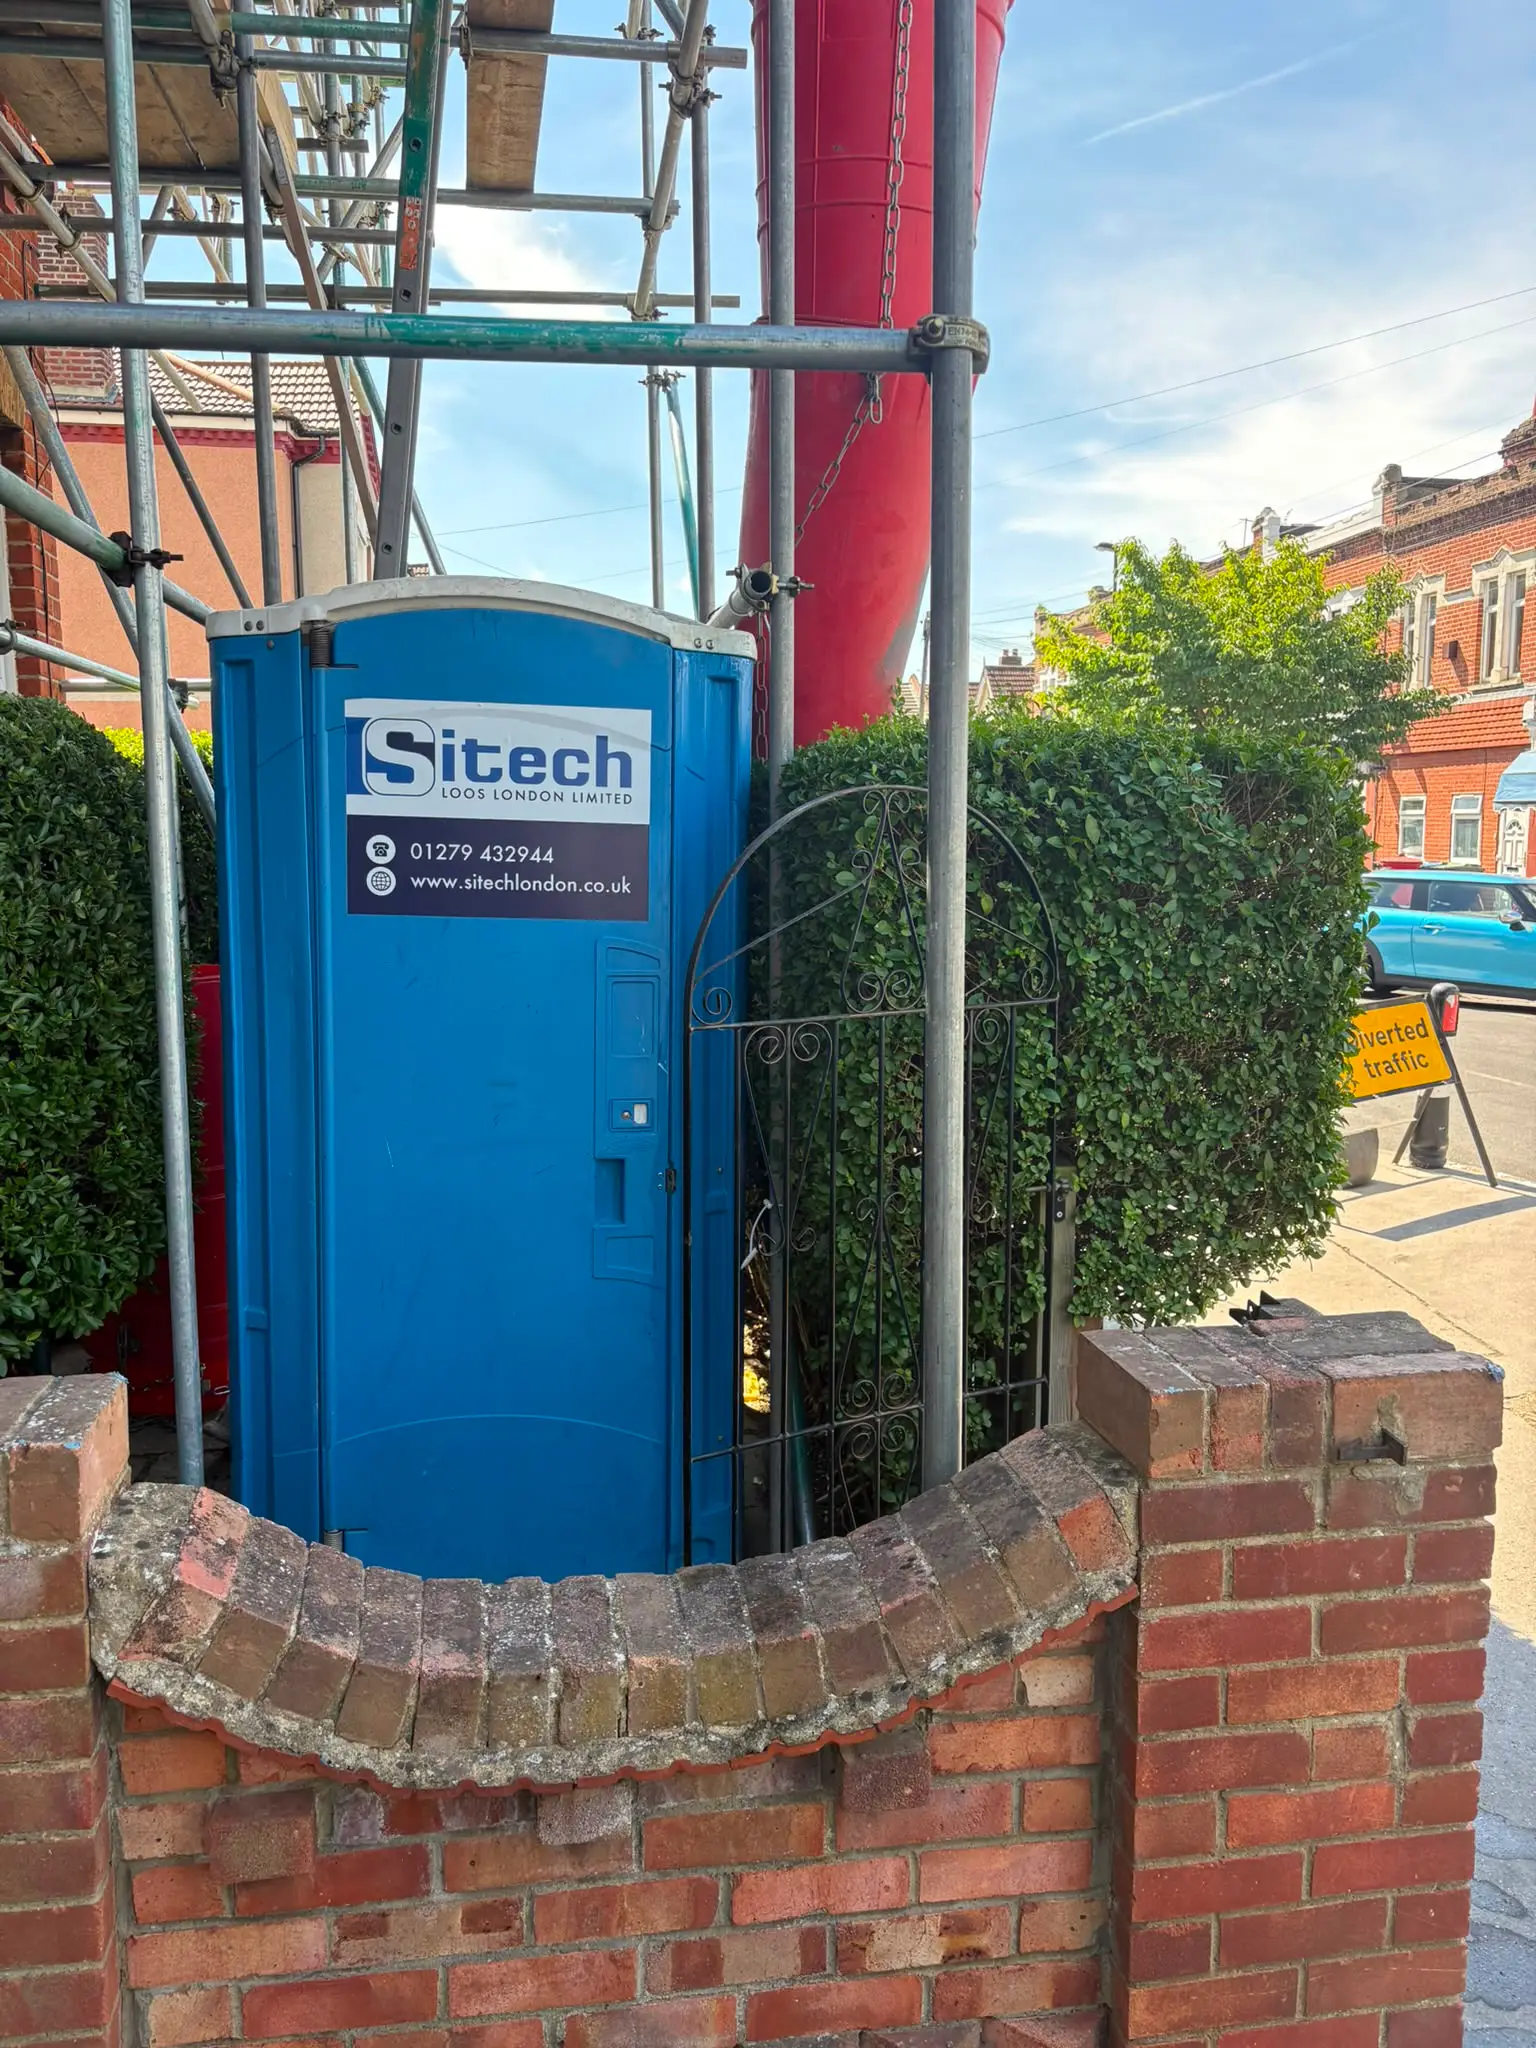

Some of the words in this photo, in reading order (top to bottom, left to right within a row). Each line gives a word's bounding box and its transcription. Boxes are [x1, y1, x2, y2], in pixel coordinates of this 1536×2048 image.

[363, 717, 633, 797] Sitech
[441, 787, 486, 800] LOOS
[493, 788, 564, 802] LONDON
[572, 791, 632, 805] LIMITED
[410, 842, 473, 861] 01279
[479, 844, 555, 864] 432944
[410, 872, 632, 894] www.sitechlondon.co.uk
[1363, 1050, 1429, 1079] traffic
